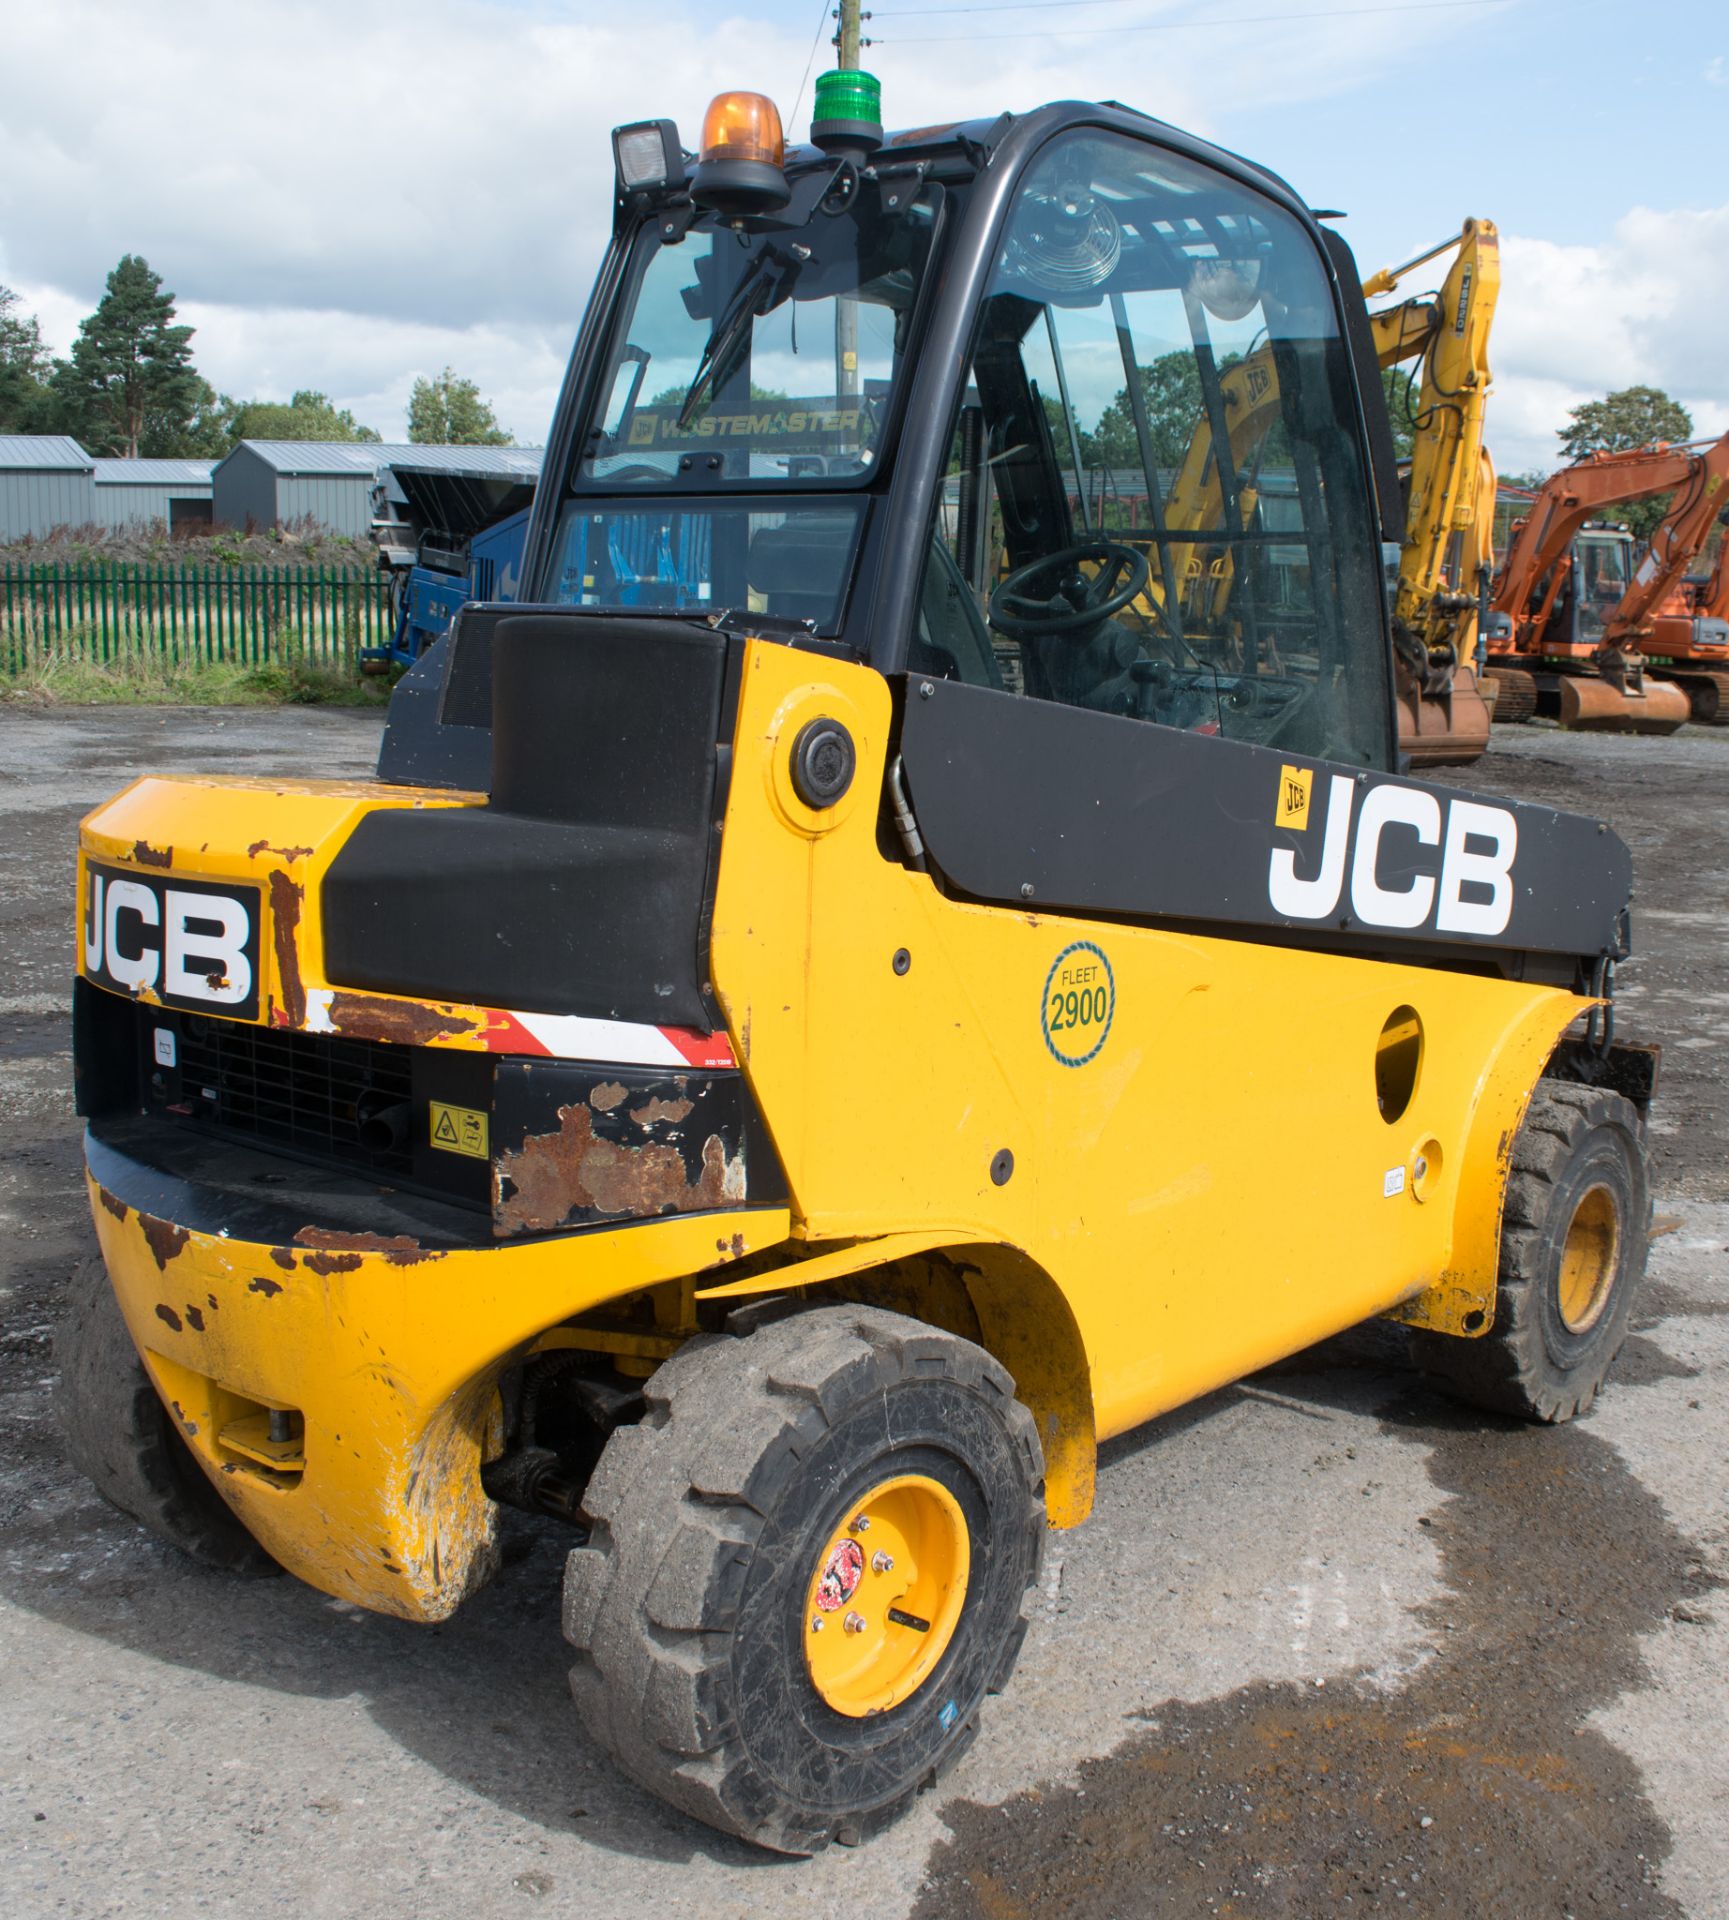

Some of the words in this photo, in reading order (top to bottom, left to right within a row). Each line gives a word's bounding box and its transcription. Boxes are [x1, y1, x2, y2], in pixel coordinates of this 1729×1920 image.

[1247, 369, 1269, 402] JCB
[1287, 782, 1304, 811] JCB
[1268, 774, 1518, 936] JCB
[85, 872, 252, 1004] JCB
[1062, 966, 1098, 986] FLEET
[1050, 986, 1107, 1031] 2900
